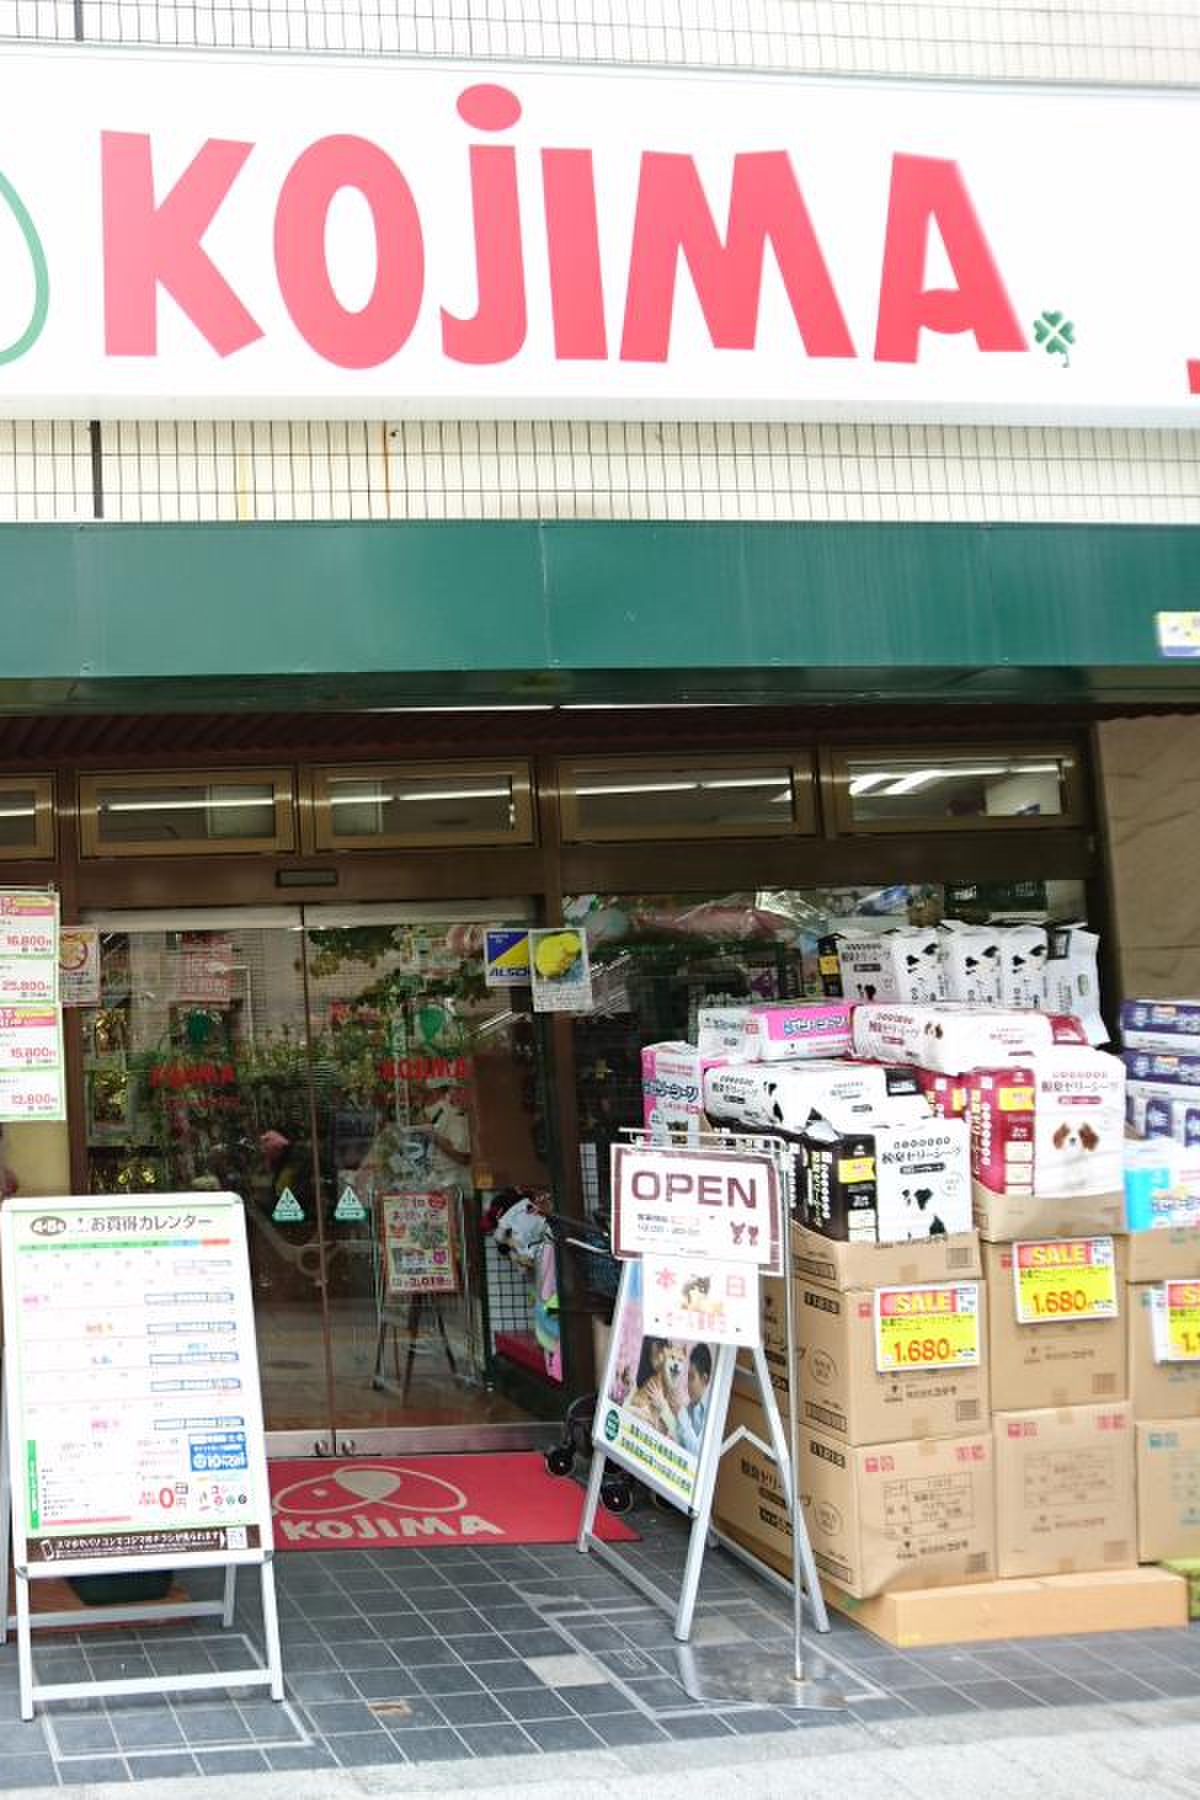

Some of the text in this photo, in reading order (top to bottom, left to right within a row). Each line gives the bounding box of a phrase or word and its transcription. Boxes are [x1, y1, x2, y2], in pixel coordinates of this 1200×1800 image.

[100, 83, 1029, 370] KOJIMA
[489, 967, 531, 977] ALSO
[631, 1170, 757, 1209] OPEN
[1032, 1243, 1086, 1265] SALE
[896, 1290, 951, 1314] SALE
[280, 1513, 505, 1542] KOJIMA
